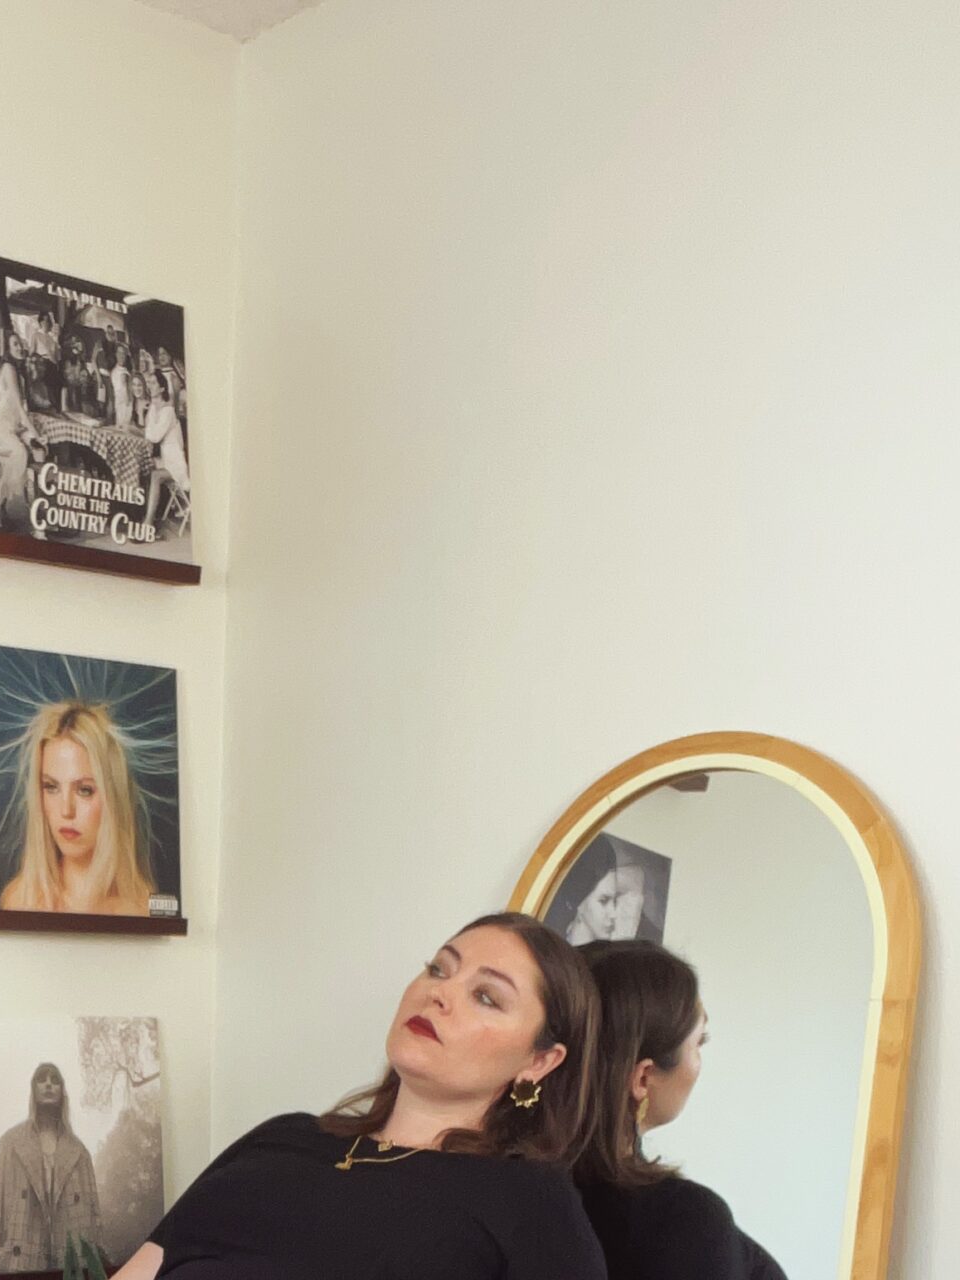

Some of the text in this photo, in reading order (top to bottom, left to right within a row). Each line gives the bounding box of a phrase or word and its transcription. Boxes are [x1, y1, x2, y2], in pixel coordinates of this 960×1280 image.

[38, 462, 145, 506] CHEMTRAILS
[57, 492, 111, 515] OVER THE
[30, 497, 156, 545] COUNTRY CLUB
